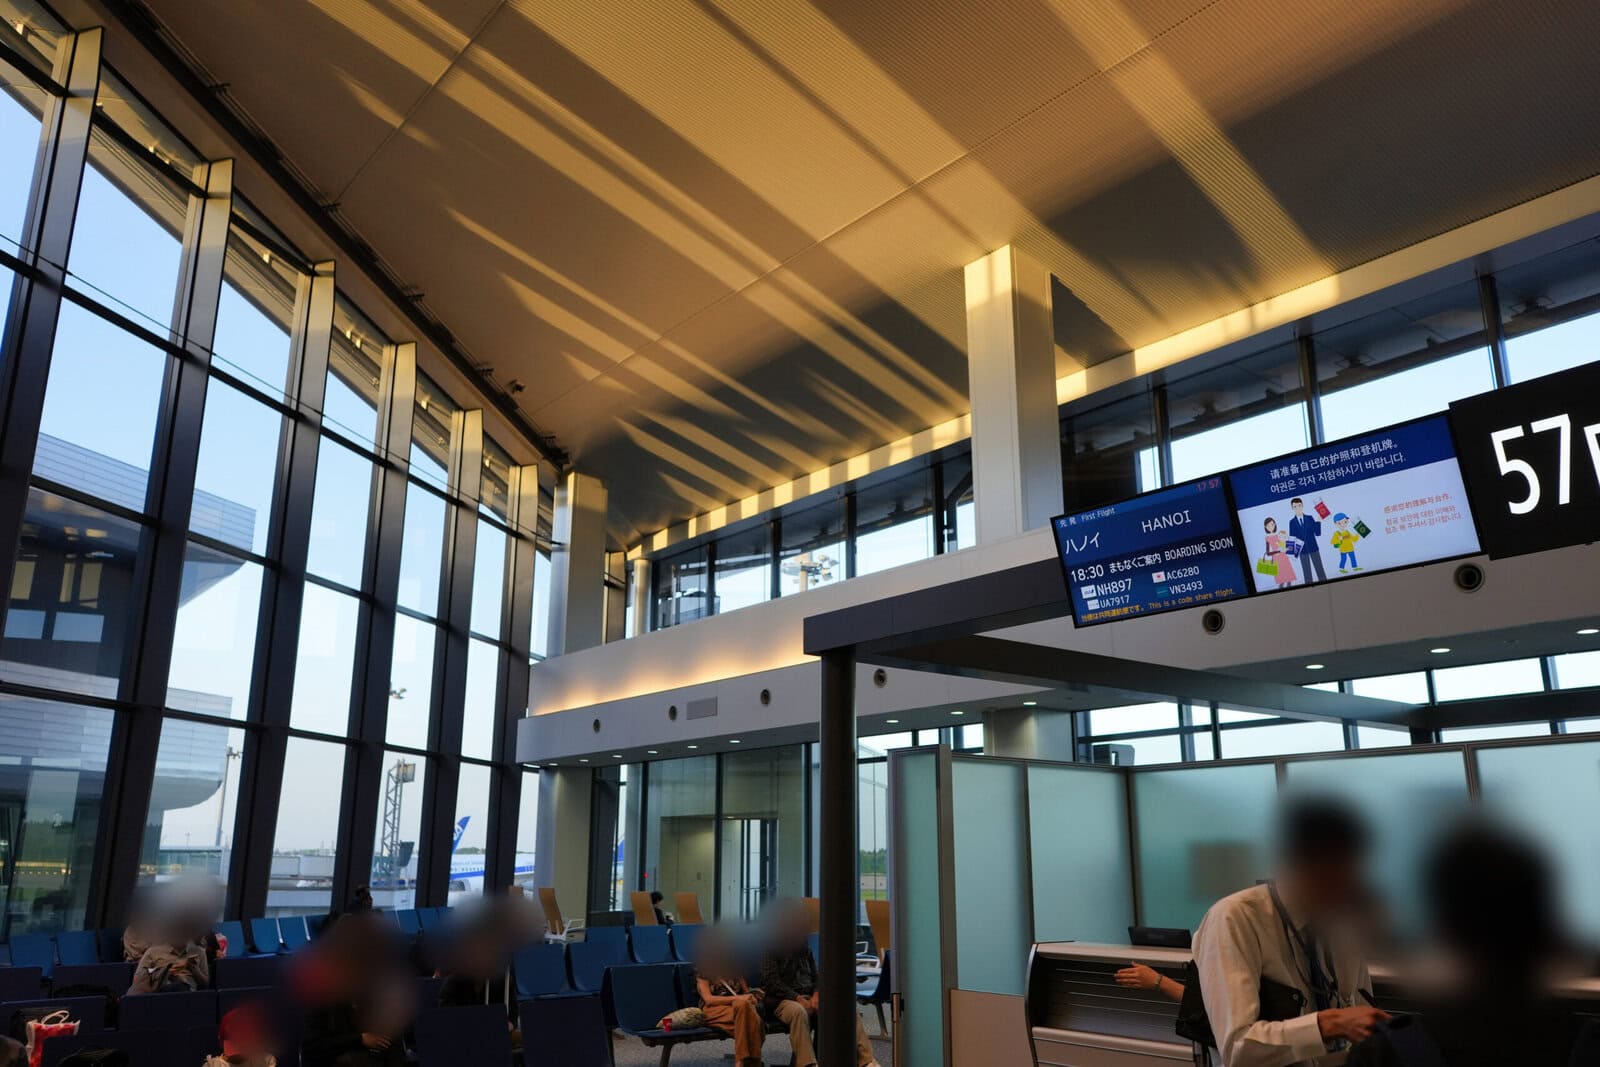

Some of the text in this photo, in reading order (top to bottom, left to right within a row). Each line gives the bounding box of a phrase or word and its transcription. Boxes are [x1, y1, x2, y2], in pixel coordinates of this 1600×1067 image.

[1270, 438, 1399, 480] 请准备自己的护照和登机牌。
[1270, 480, 1297, 494] 여권은
[1298, 474, 1316, 487] 각자
[1318, 462, 1364, 482] 지참하시기
[1081, 507, 1116, 522] First Flight
[1141, 510, 1192, 533] HANOI
[1065, 532, 1101, 555] ハノイ
[1164, 536, 1235, 562] BOARDING SOON
[1071, 564, 1105, 583] 18:30
[1108, 553, 1162, 575] まもなくご案内
[1166, 566, 1200, 581] AC6280
[1097, 578, 1132, 597] NH897
[1169, 580, 1204, 595] VN3493
[1100, 594, 1130, 609] UA7917
